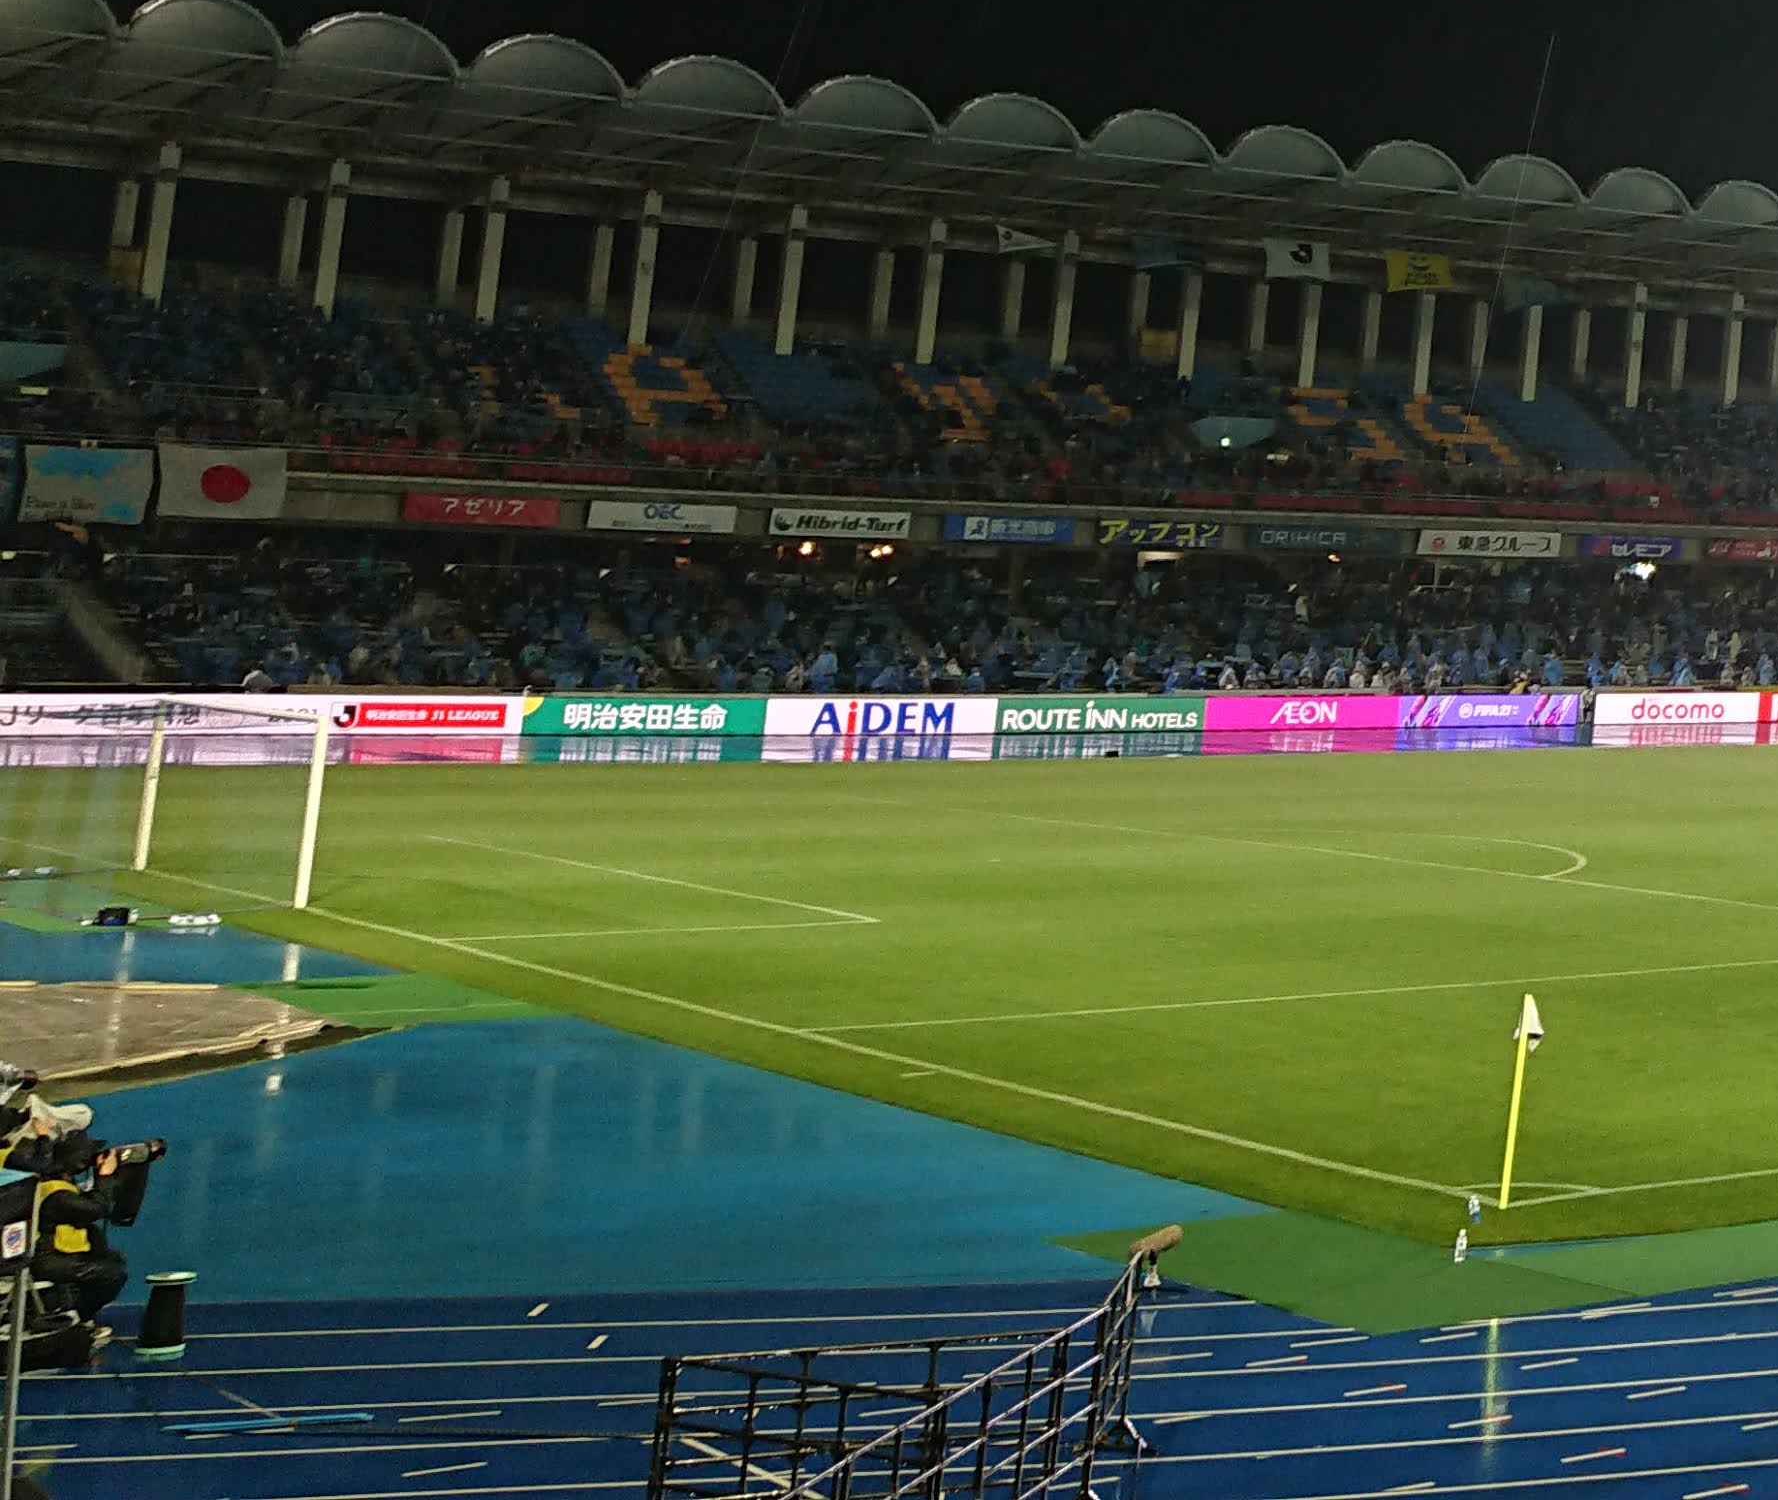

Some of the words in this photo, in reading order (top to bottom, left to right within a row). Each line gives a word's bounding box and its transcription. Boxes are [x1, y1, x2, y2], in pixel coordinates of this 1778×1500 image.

[442, 496, 526, 517] アゼリア
[1259, 530, 1346, 546] ORIHICA
[447, 708, 500, 721] LEAGUE
[563, 703, 729, 731] 明治安田生命
[1002, 708, 1081, 731] ROUTE
[1130, 711, 1199, 729] HOTELS
[1631, 698, 1725, 720] docomo
